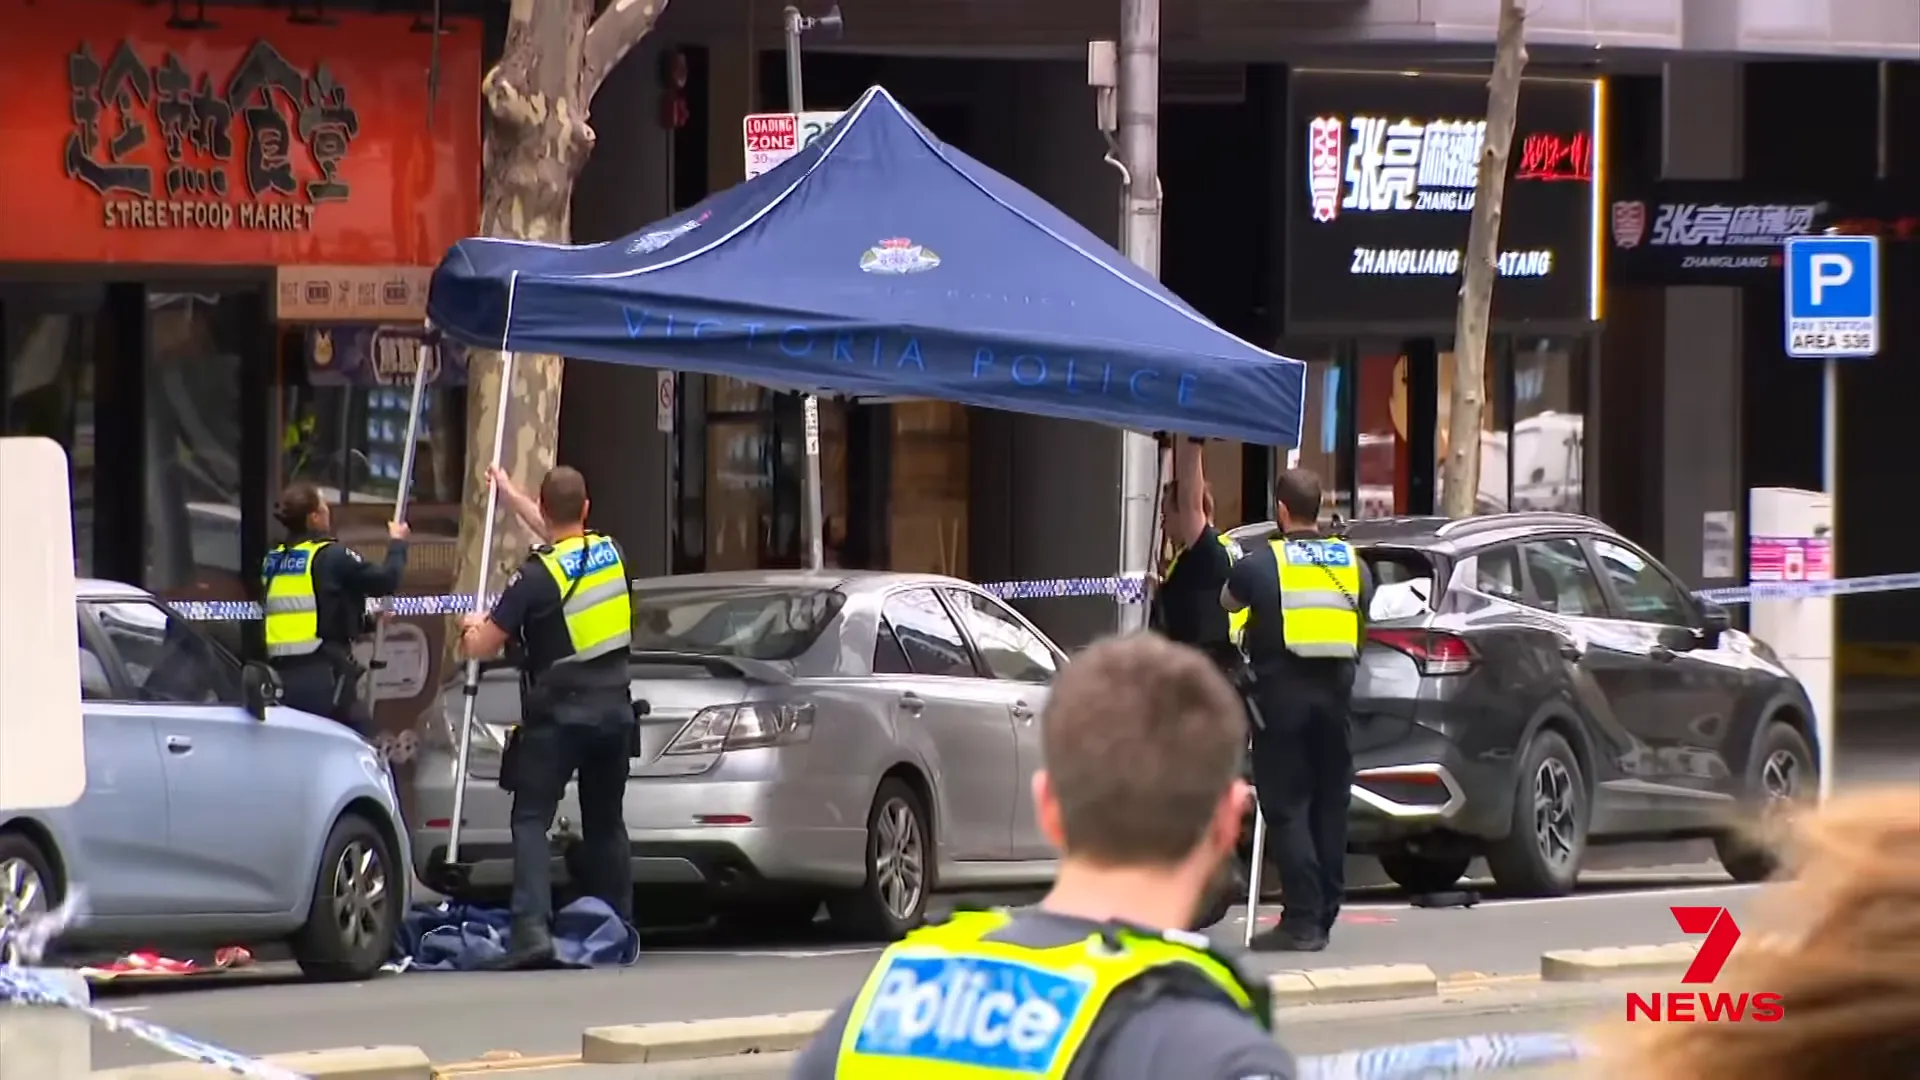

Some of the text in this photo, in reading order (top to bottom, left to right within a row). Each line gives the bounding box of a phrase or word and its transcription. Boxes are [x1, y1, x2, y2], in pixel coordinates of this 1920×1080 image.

[748, 119, 792, 133] LOADING
[748, 135, 793, 149] ZONE
[1343, 117, 1488, 210] 张亮麻辣
[1415, 191, 1457, 211] ZHANG
[104, 201, 315, 230] STREETFOOD MARKET
[1350, 248, 1461, 275] ZHANGLIANG
[1680, 256, 1769, 268] ZHANGLIANG
[1809, 254, 1854, 306] P
[1793, 333, 1837, 350] AREA
[621, 305, 1198, 408] VICTORIA POLICE
[266, 553, 305, 571] Plice
[864, 967, 1062, 1052] Police
